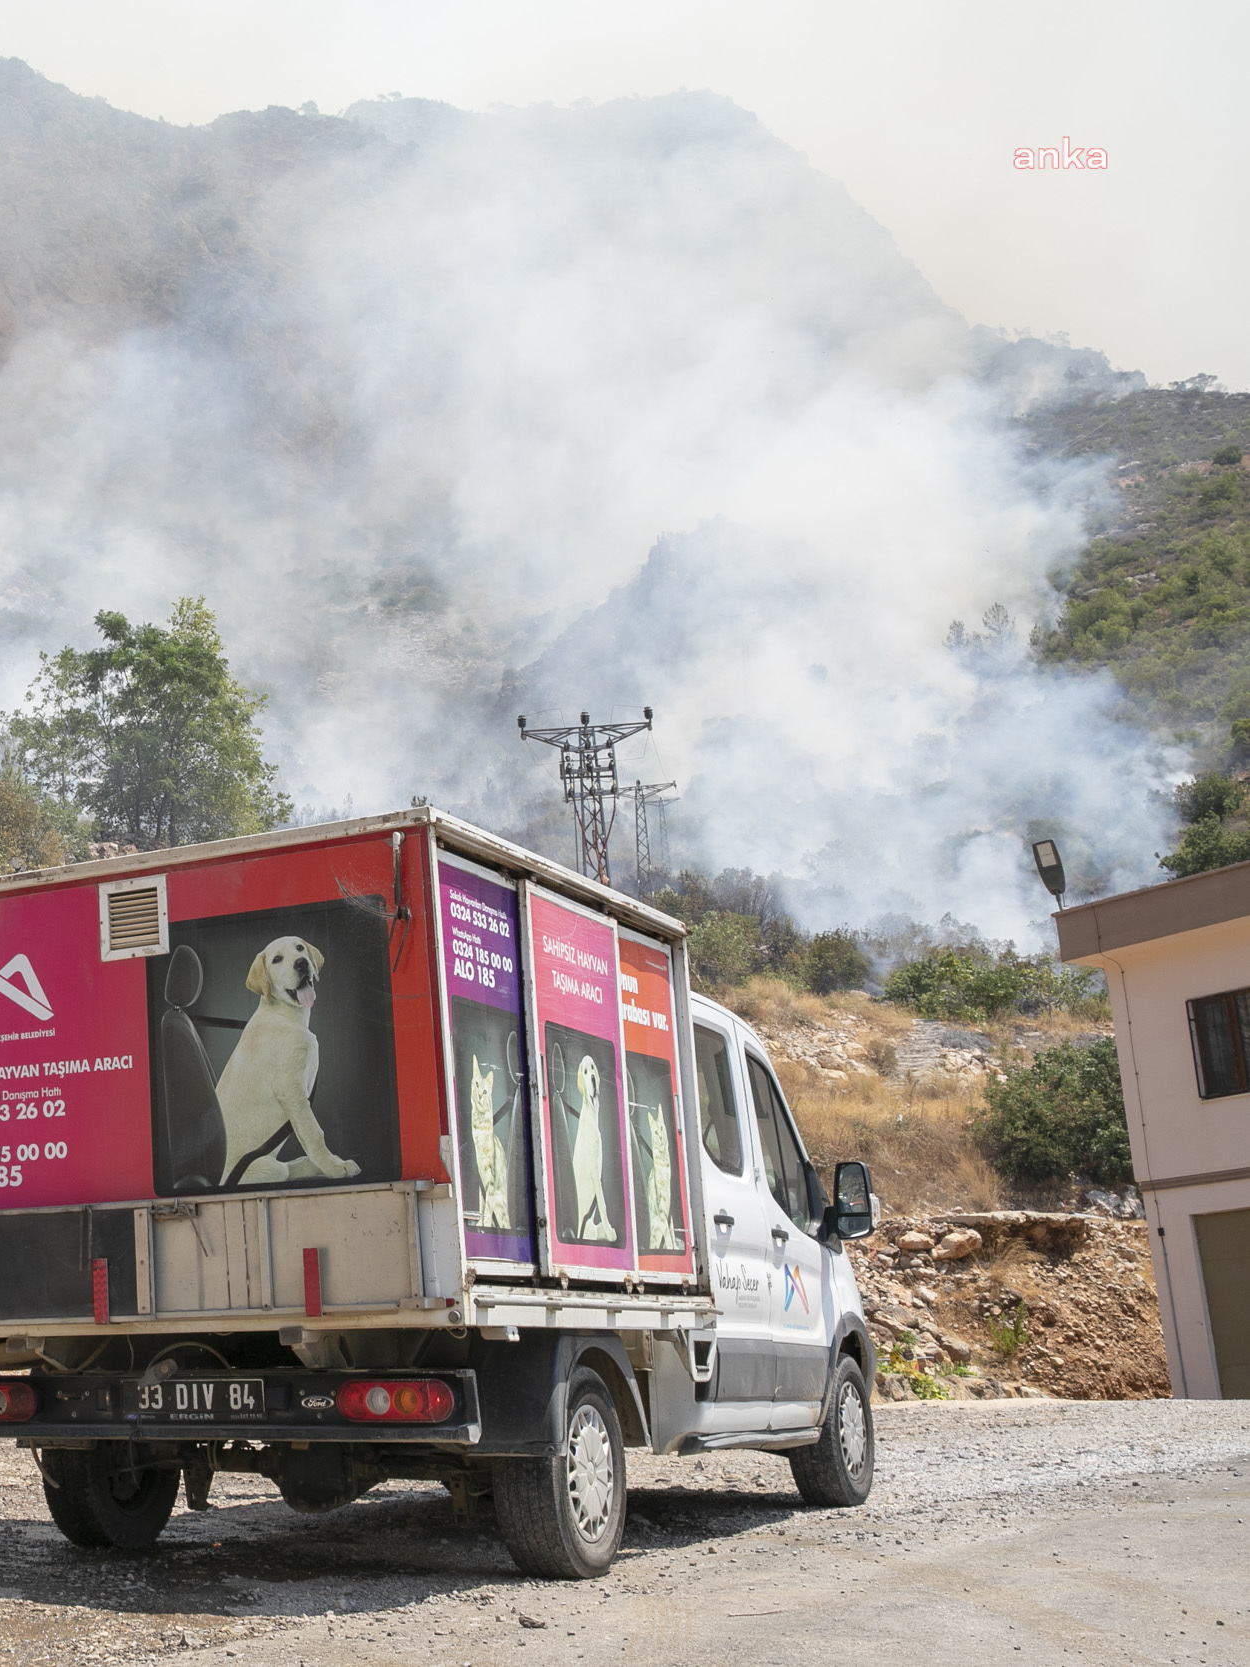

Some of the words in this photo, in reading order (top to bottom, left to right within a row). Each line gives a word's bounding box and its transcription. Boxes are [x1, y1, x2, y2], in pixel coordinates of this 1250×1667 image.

[450, 902, 471, 922] 0324
[472, 911, 487, 929] 533
[488, 917, 498, 934] 26
[499, 921, 510, 938] 02
[452, 939, 473, 960] 0324
[475, 947, 489, 966] 185
[491, 952, 501, 969] 00
[502, 956, 513, 973] 00
[542, 935, 576, 964] SAHİPSİZ
[576, 950, 608, 976] HAYVAN
[453, 958, 475, 981] ALO
[477, 965, 495, 988] 185
[552, 970, 580, 996] TAŞIMA
[581, 981, 603, 1004] ARACI
[20, 1027, 56, 1040] BELEDİYESİ
[43, 1059, 90, 1078] TAŞIMA
[93, 1055, 133, 1071] ARACI
[2, 1089, 39, 1102] Danışma
[41, 1086, 62, 1098] Hattı
[15, 1102, 38, 1120] 26
[42, 1099, 66, 1118] 02
[16, 1143, 39, 1161] 00
[44, 1141, 68, 1160] 00
[137, 1383, 163, 1410] 33
[175, 1383, 214, 1410] DIV
[229, 1383, 255, 1410] 84
